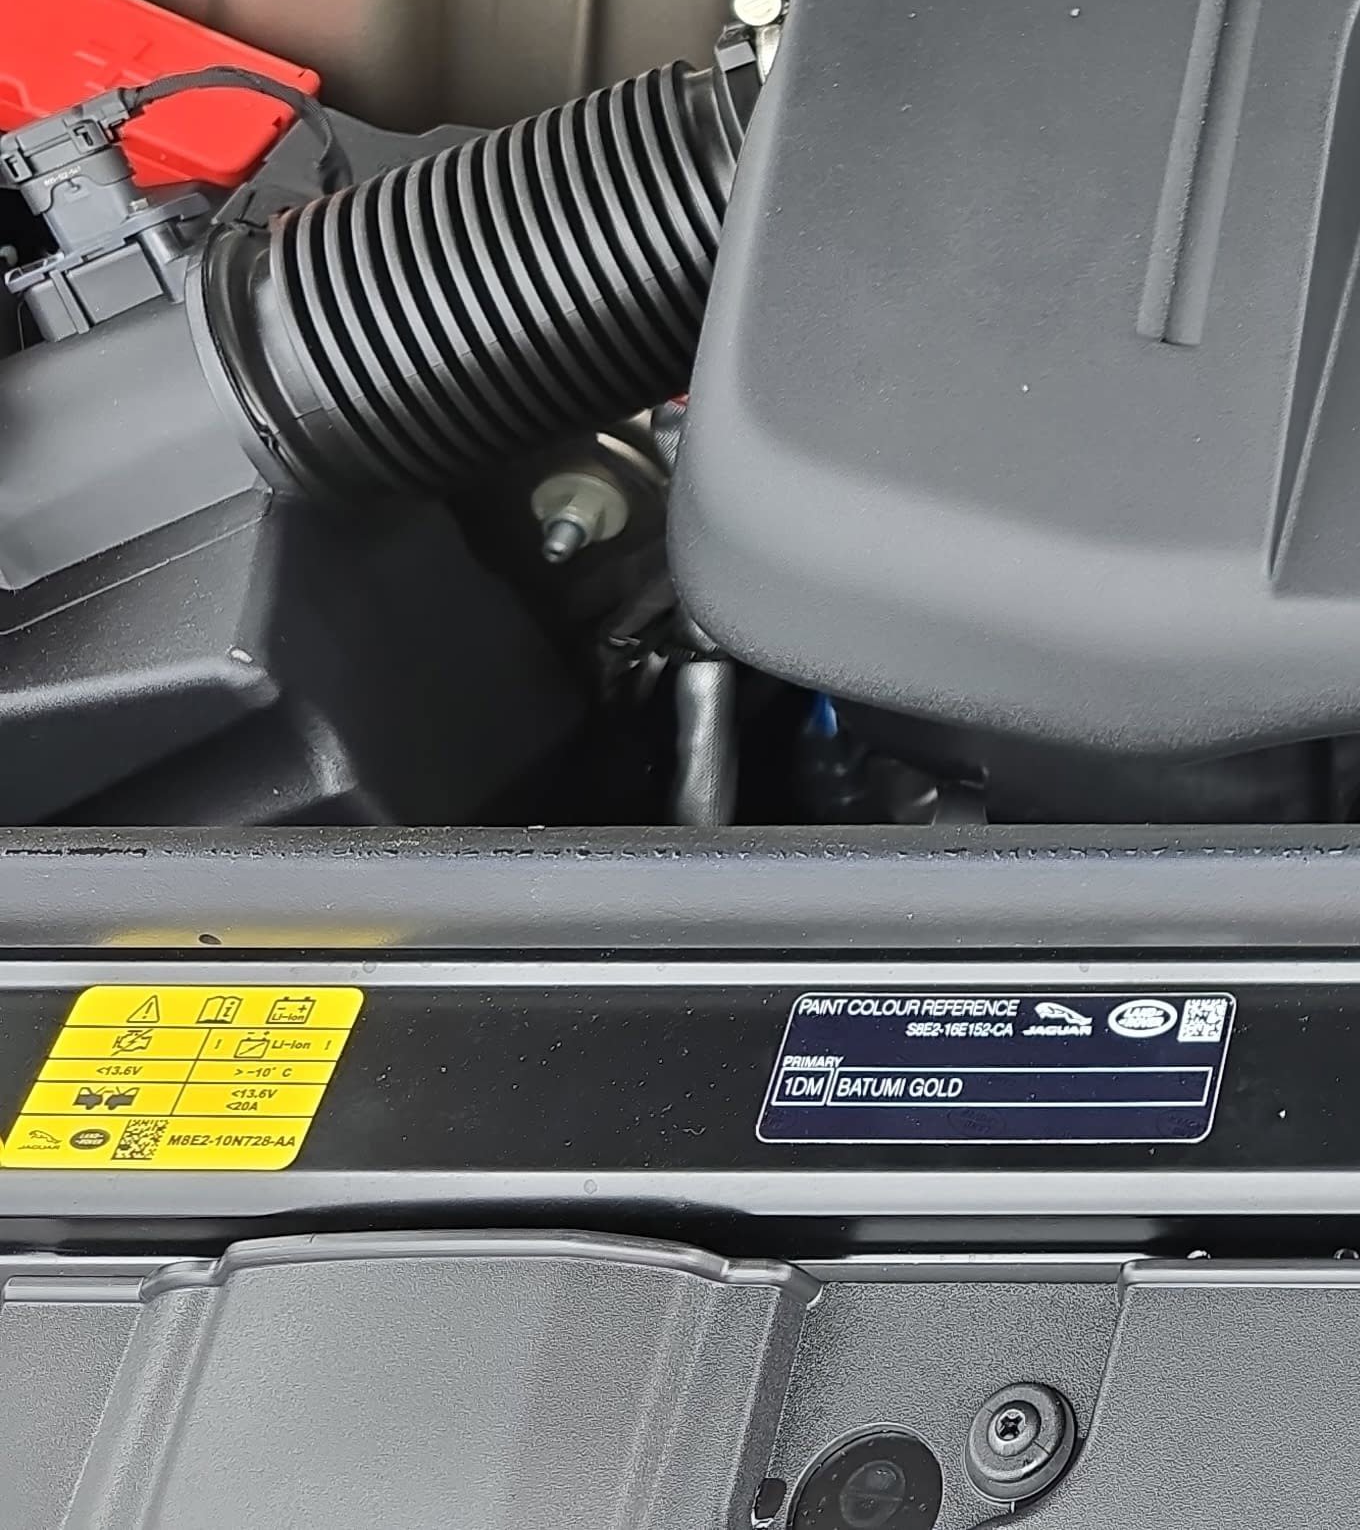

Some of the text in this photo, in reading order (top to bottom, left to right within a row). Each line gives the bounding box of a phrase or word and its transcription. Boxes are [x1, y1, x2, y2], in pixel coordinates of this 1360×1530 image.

[798, 999, 1020, 1017] PAINT COLOUR REFERENCE
[1022, 1025, 1093, 1036] JAGUAR
[271, 1039, 311, 1049] Li-ion
[782, 1055, 844, 1067] PRIMARY
[784, 1077, 824, 1097] 1DM
[836, 1077, 964, 1097] BATUMI GOLD
[226, 1101, 258, 1111] <20A
[166, 1134, 296, 1147] M8E2-10N728-AA
